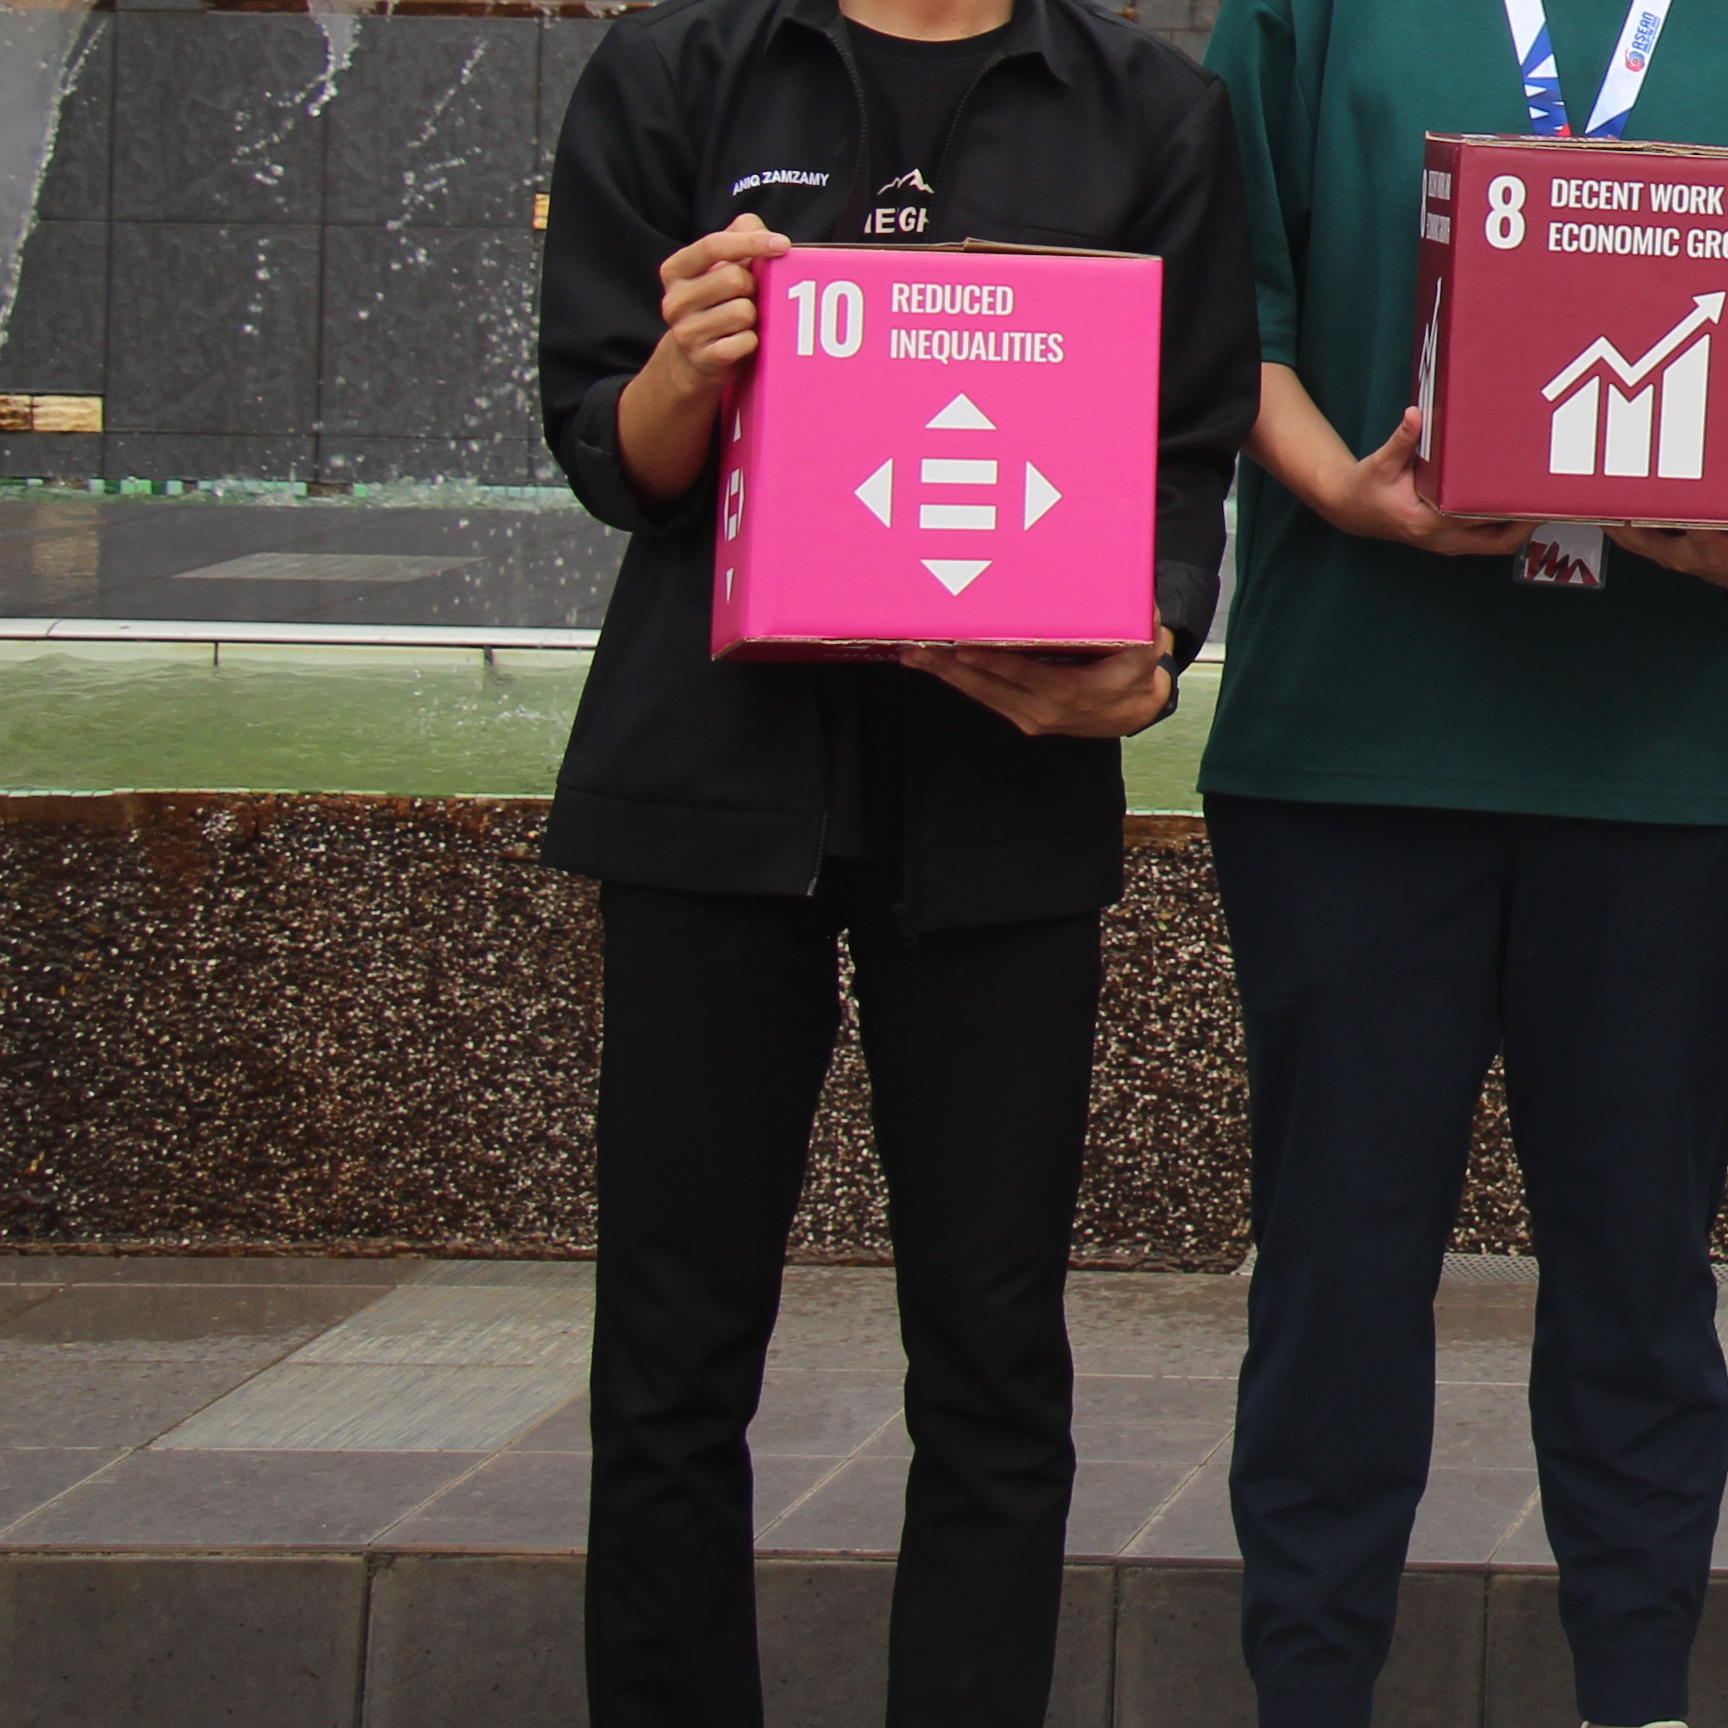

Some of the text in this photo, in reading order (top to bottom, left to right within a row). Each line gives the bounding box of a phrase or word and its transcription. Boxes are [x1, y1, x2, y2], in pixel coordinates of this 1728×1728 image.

[732, 170, 830, 196] ANIQ ZAMZAMY
[1550, 178, 1644, 211] DECENT
[1649, 183, 1724, 216] WORK
[1485, 175, 1526, 250] 8
[1547, 222, 1680, 257] ECONOMIC
[891, 282, 1014, 316] REDUCED
[788, 280, 864, 358] 10
[890, 329, 1064, 365] INEQUALITIES
